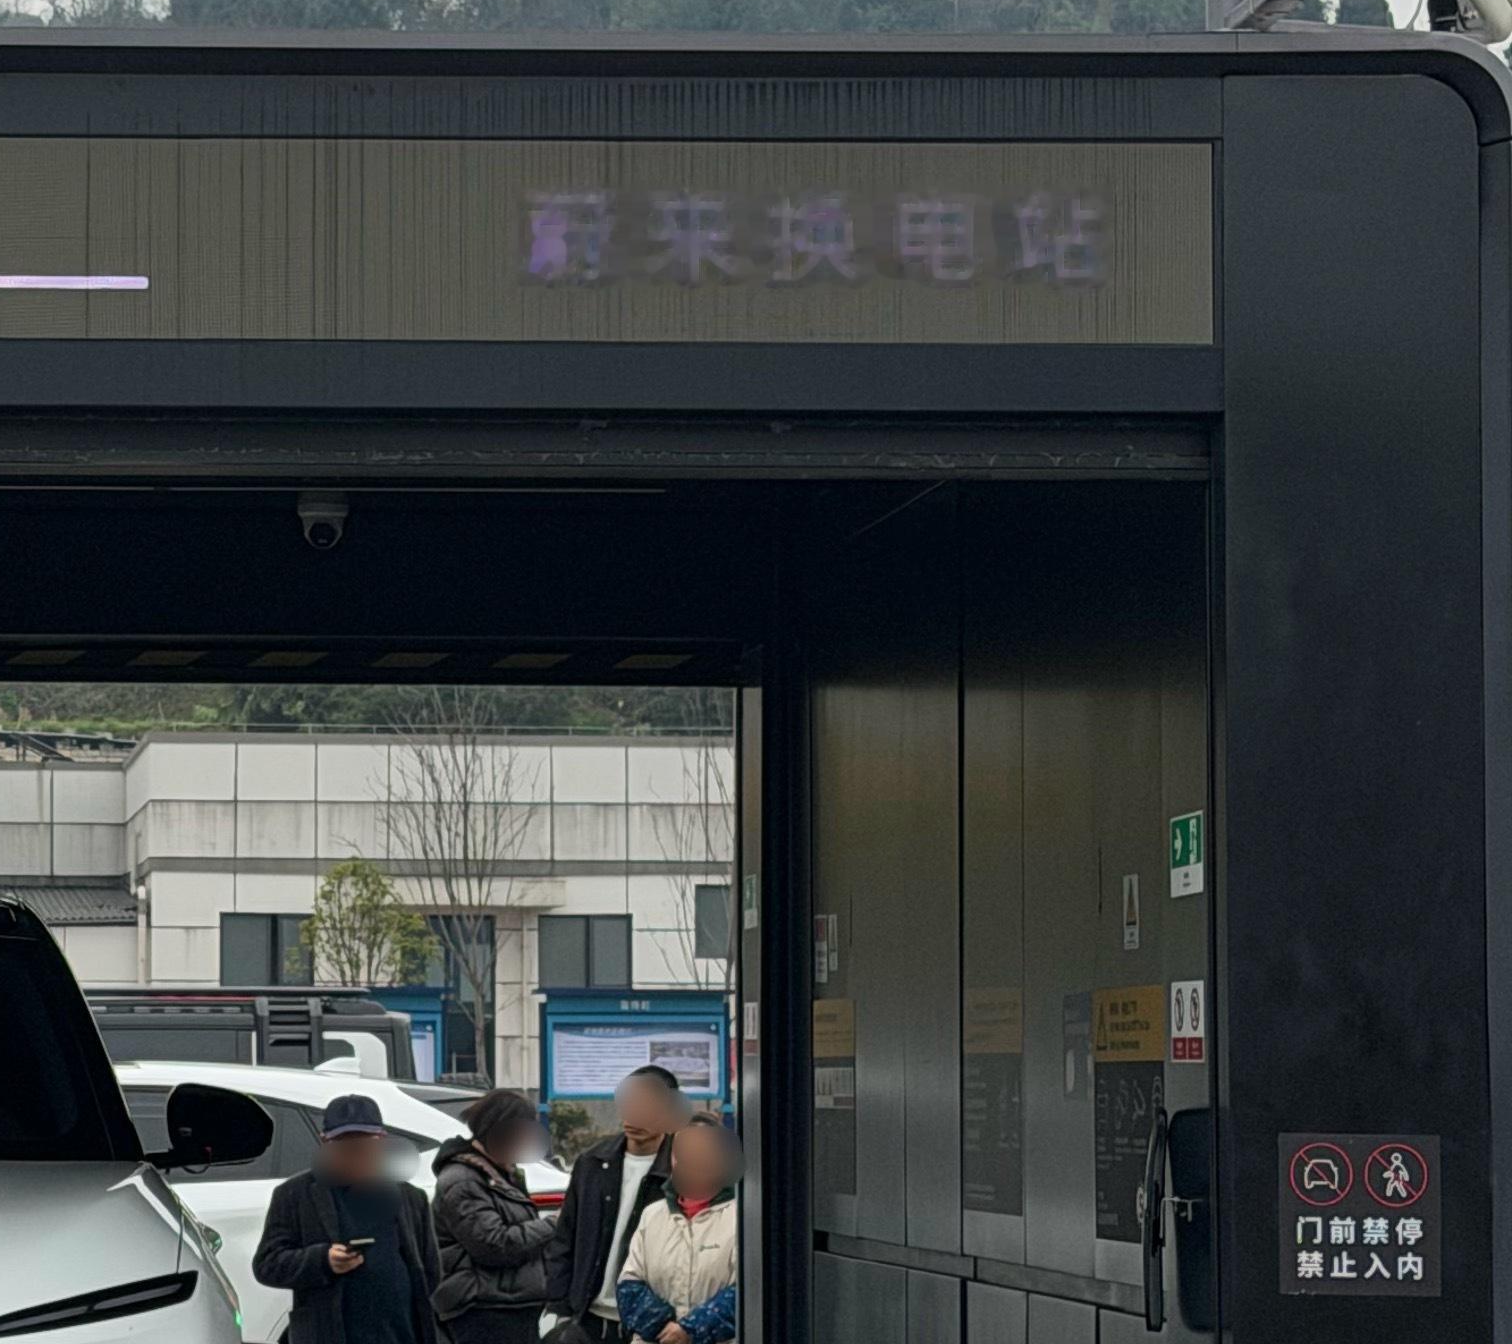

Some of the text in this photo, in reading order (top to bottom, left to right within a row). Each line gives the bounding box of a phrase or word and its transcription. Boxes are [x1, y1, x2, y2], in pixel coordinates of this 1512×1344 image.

[1296, 1216, 1424, 1246] 门前禁停
[1296, 1250, 1424, 1281] 禁止入内
